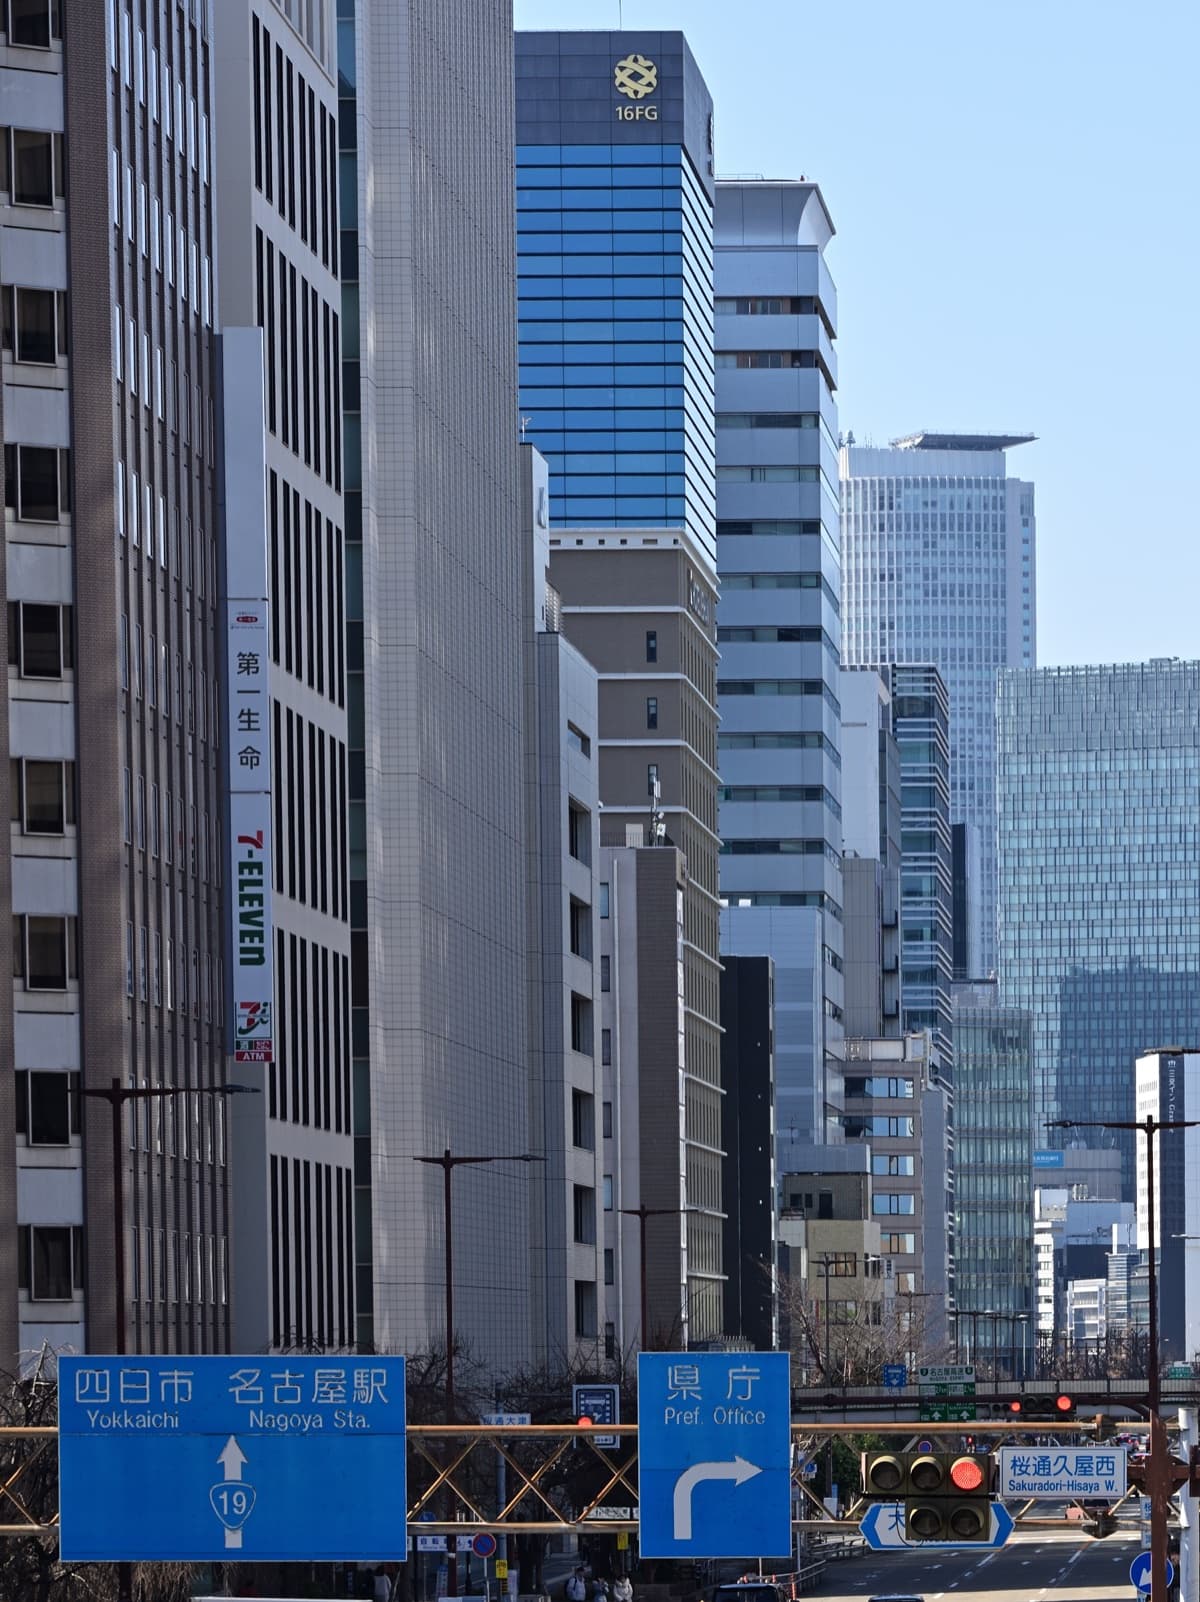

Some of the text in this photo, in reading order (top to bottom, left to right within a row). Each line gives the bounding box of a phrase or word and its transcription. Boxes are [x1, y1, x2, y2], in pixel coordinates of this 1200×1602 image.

[616, 106, 658, 121] 16FG
[237, 651, 261, 770] 第一生命
[243, 1052, 265, 1061] ATM
[74, 1367, 390, 1405] 四日市 名古屋駅
[666, 1364, 762, 1402] 県庁
[87, 1410, 371, 1432] Yokkaichi Nagoya Sta.
[664, 1406, 766, 1425] Pref. Office
[1009, 1455, 1116, 1478] 桜通久屋西
[1008, 1480, 1118, 1494] Sakuradori-Hisaya W.
[218, 1491, 247, 1515] 19
